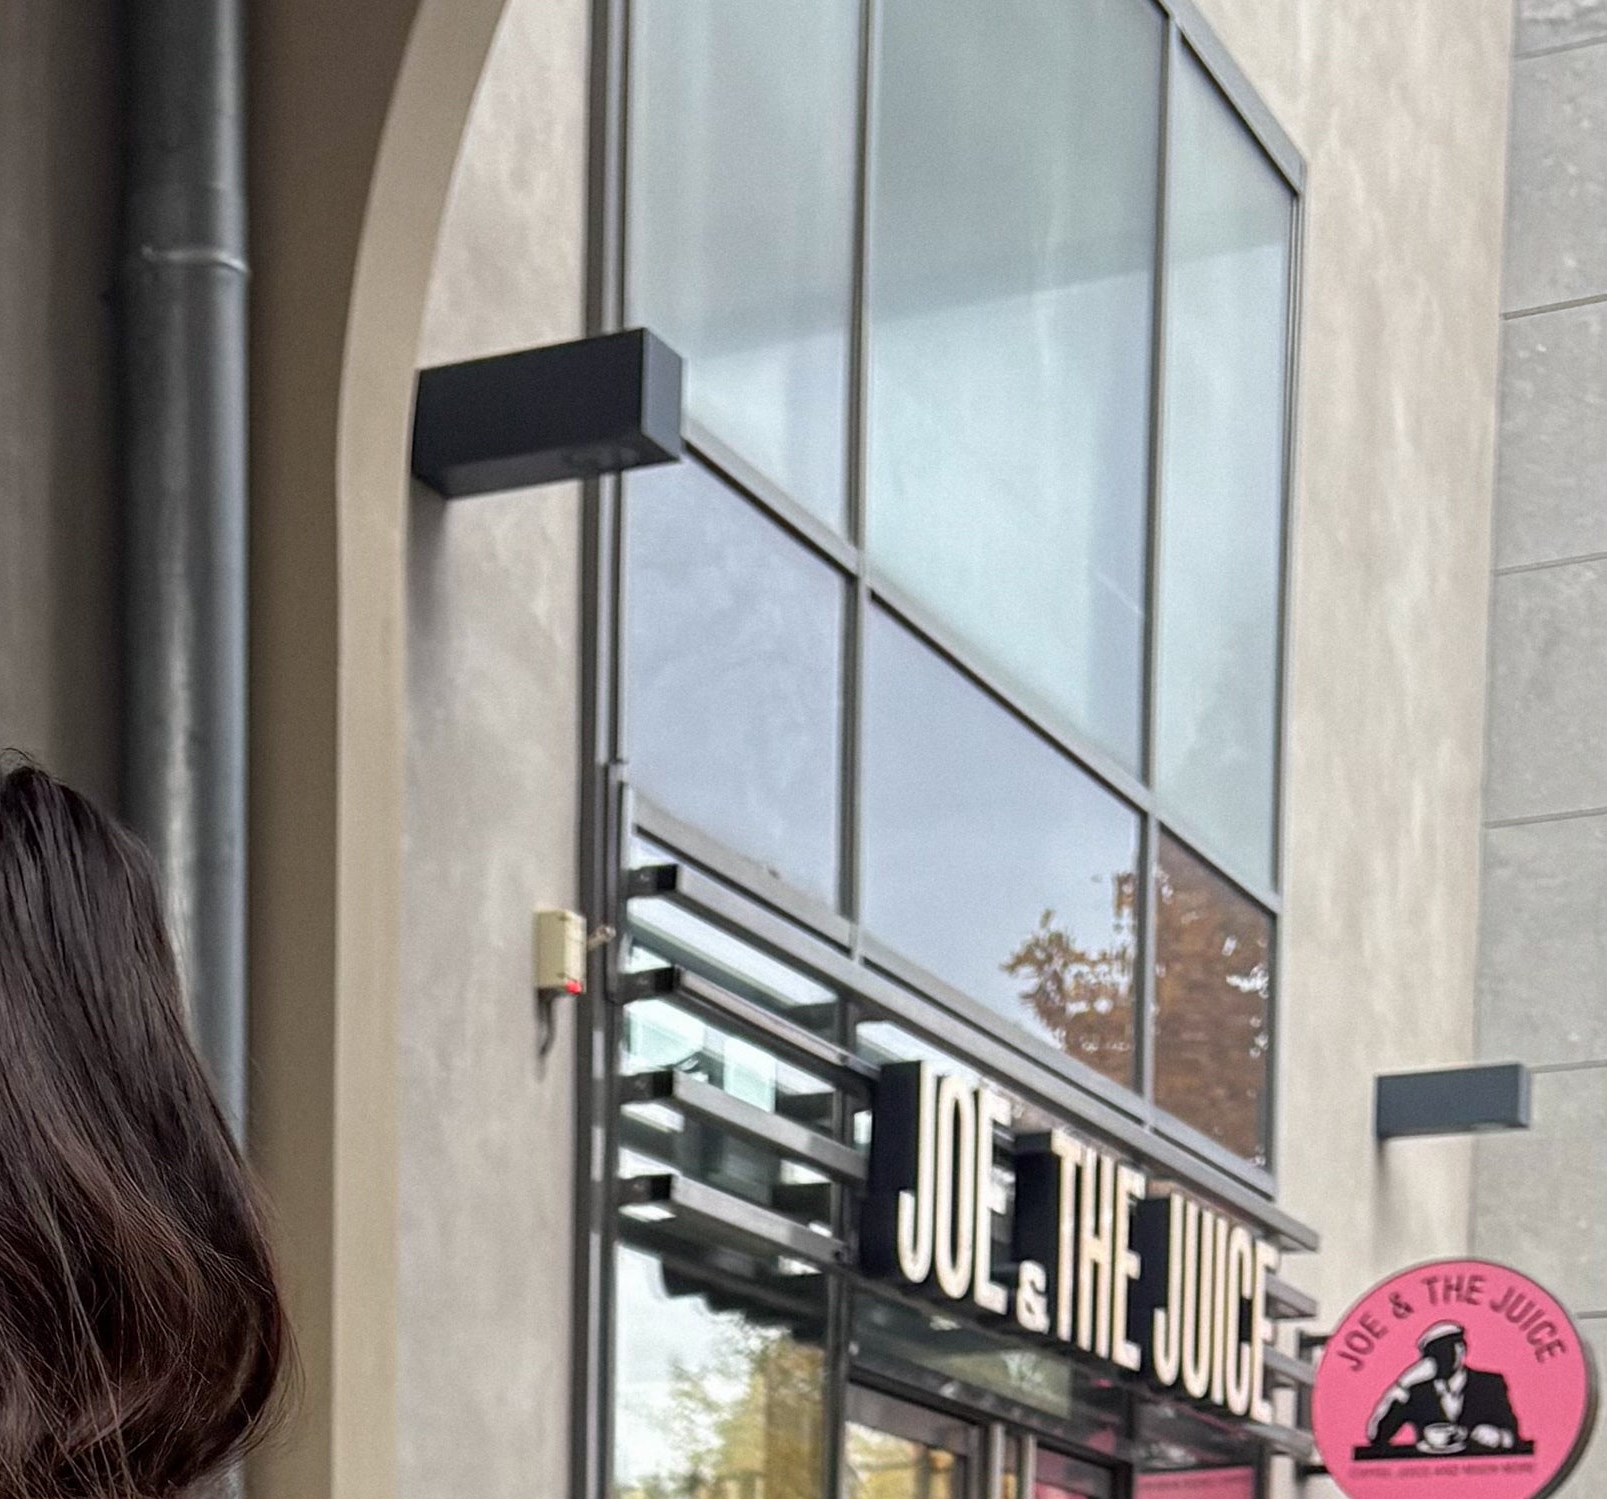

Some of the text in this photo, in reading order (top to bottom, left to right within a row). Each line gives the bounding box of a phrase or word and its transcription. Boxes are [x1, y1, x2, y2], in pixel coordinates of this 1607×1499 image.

[897, 1061, 1279, 1425] JOE & THE JUICE
[1337, 1273, 1568, 1373] JOE & THE JUICE
